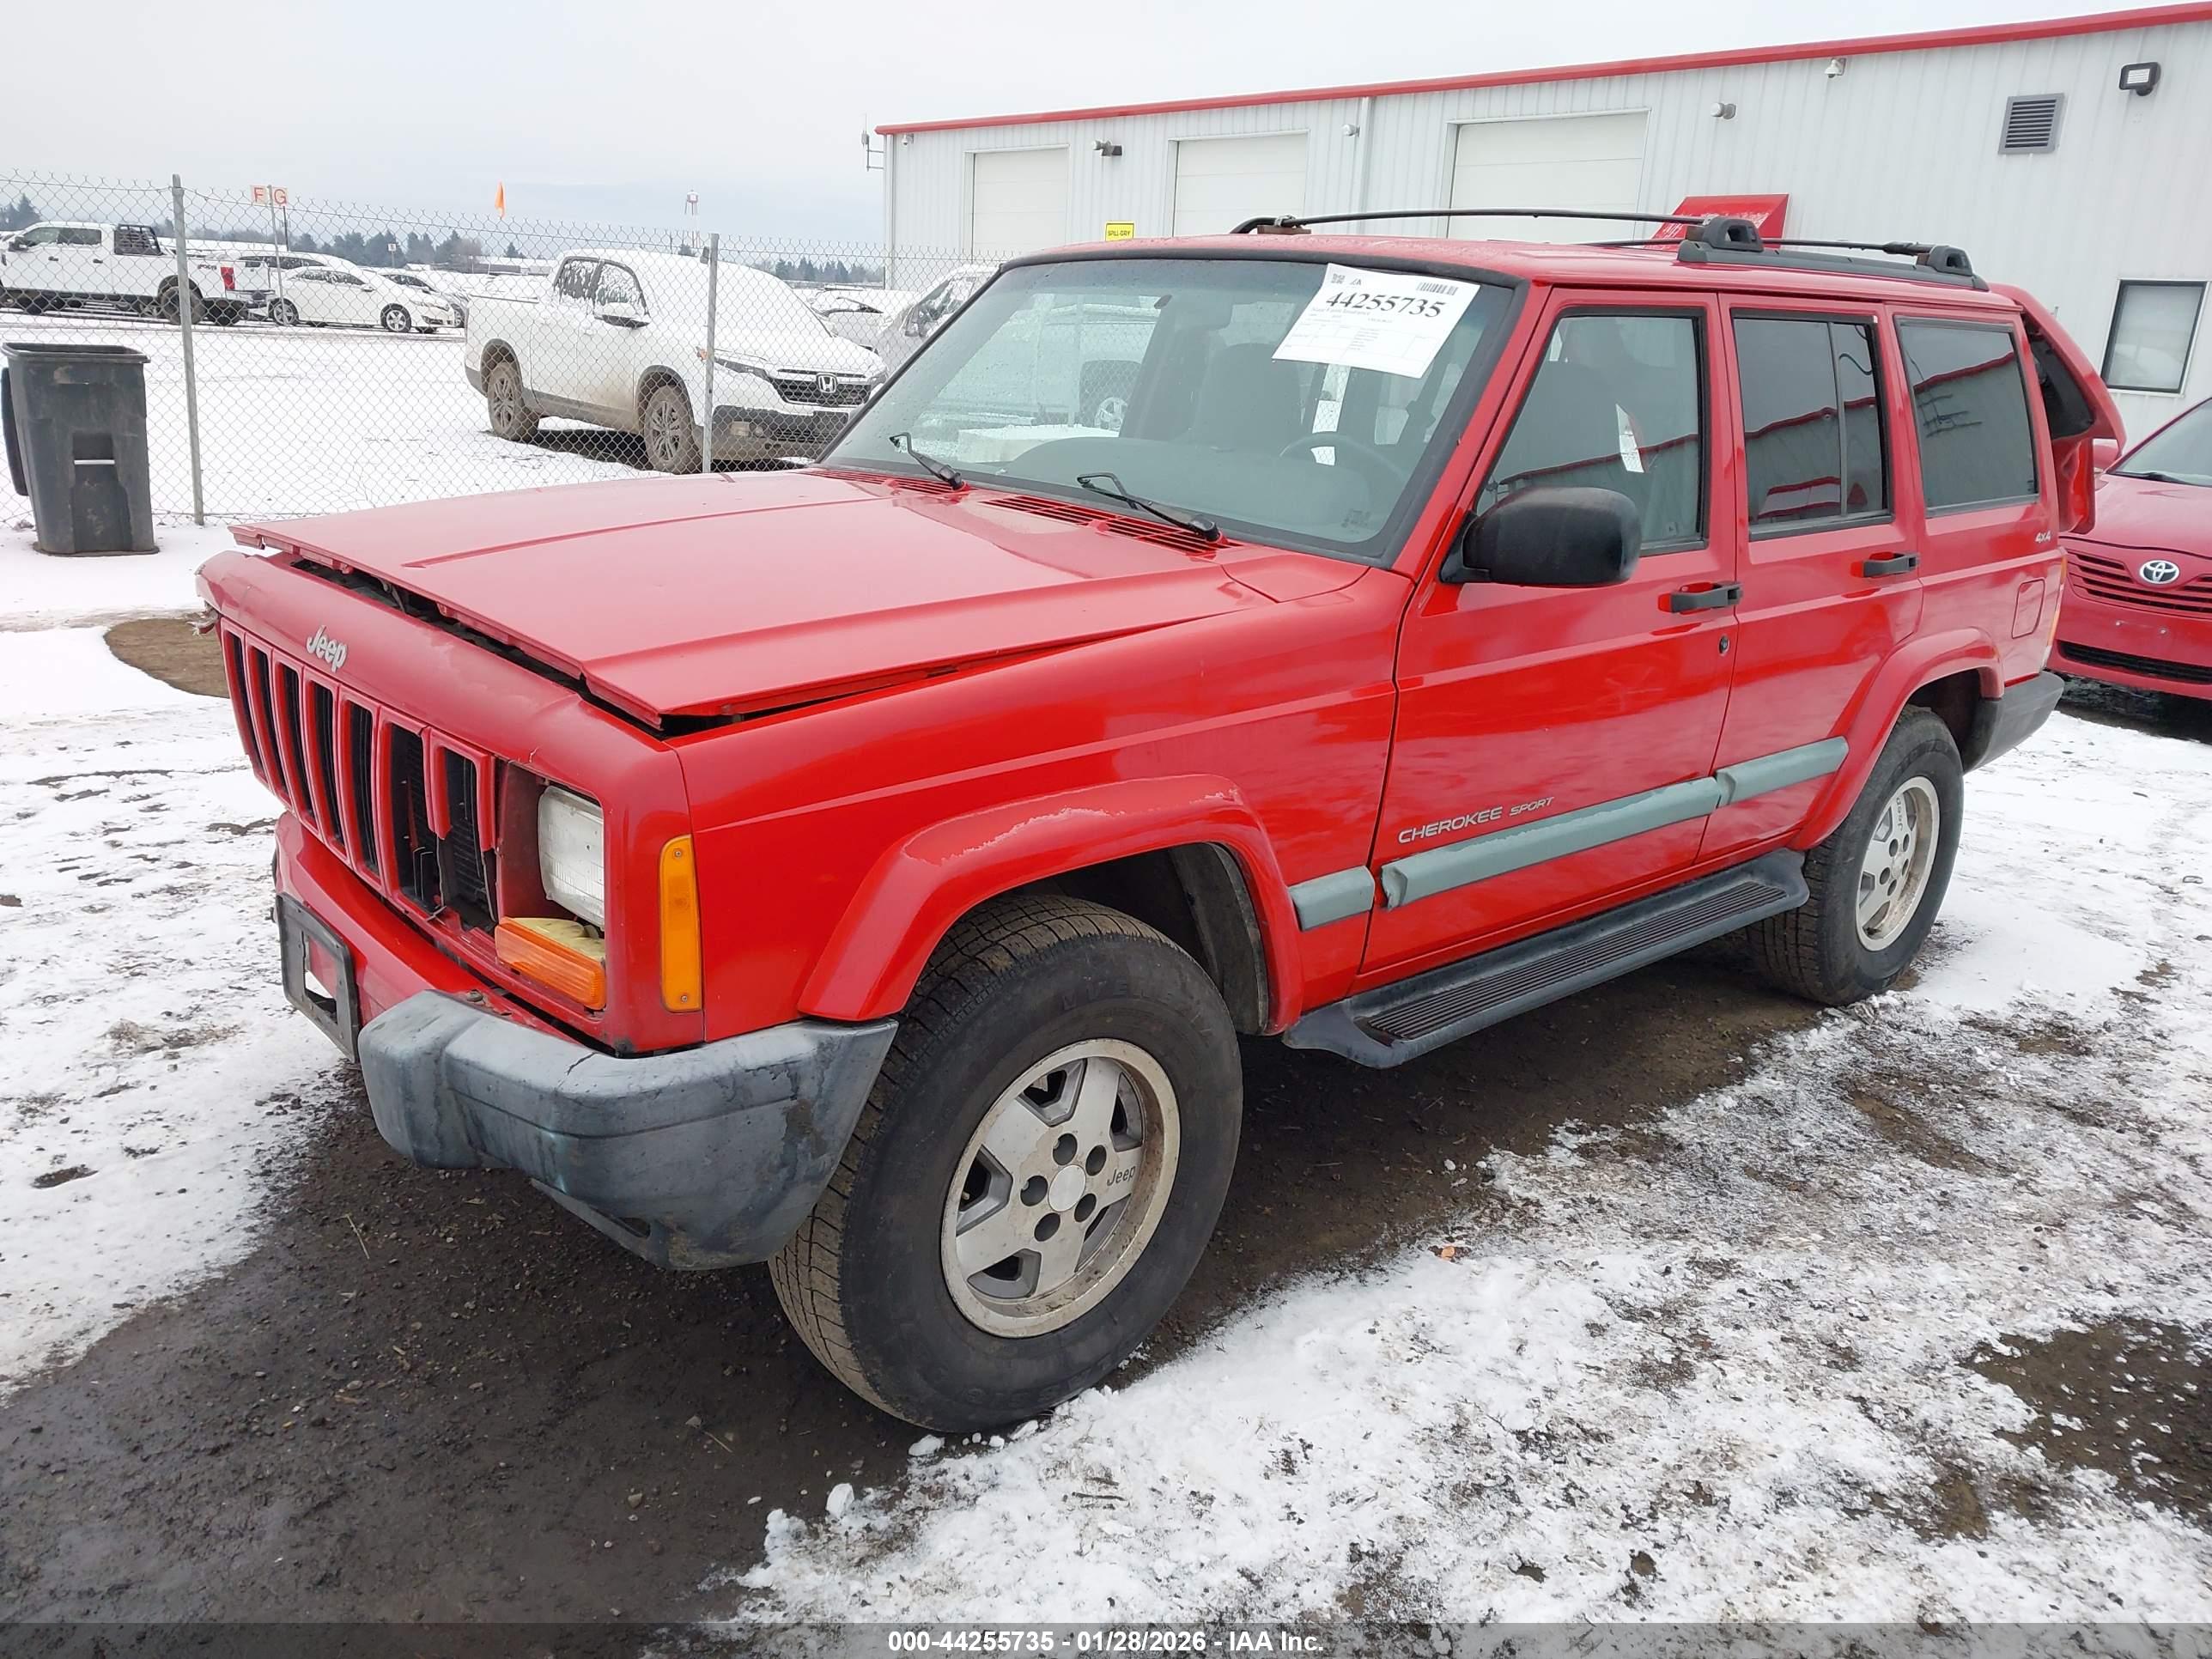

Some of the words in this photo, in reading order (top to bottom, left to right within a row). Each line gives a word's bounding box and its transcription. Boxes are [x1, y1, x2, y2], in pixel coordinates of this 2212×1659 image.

[253, 186, 264, 203] F
[274, 188, 287, 205] G
[1326, 291, 1446, 318] 44255735
[306, 624, 348, 673] Jeep
[1398, 806, 1503, 844] CHEROKEE
[1509, 796, 1555, 817] SPORT
[1106, 1165, 1136, 1187] Jeep
